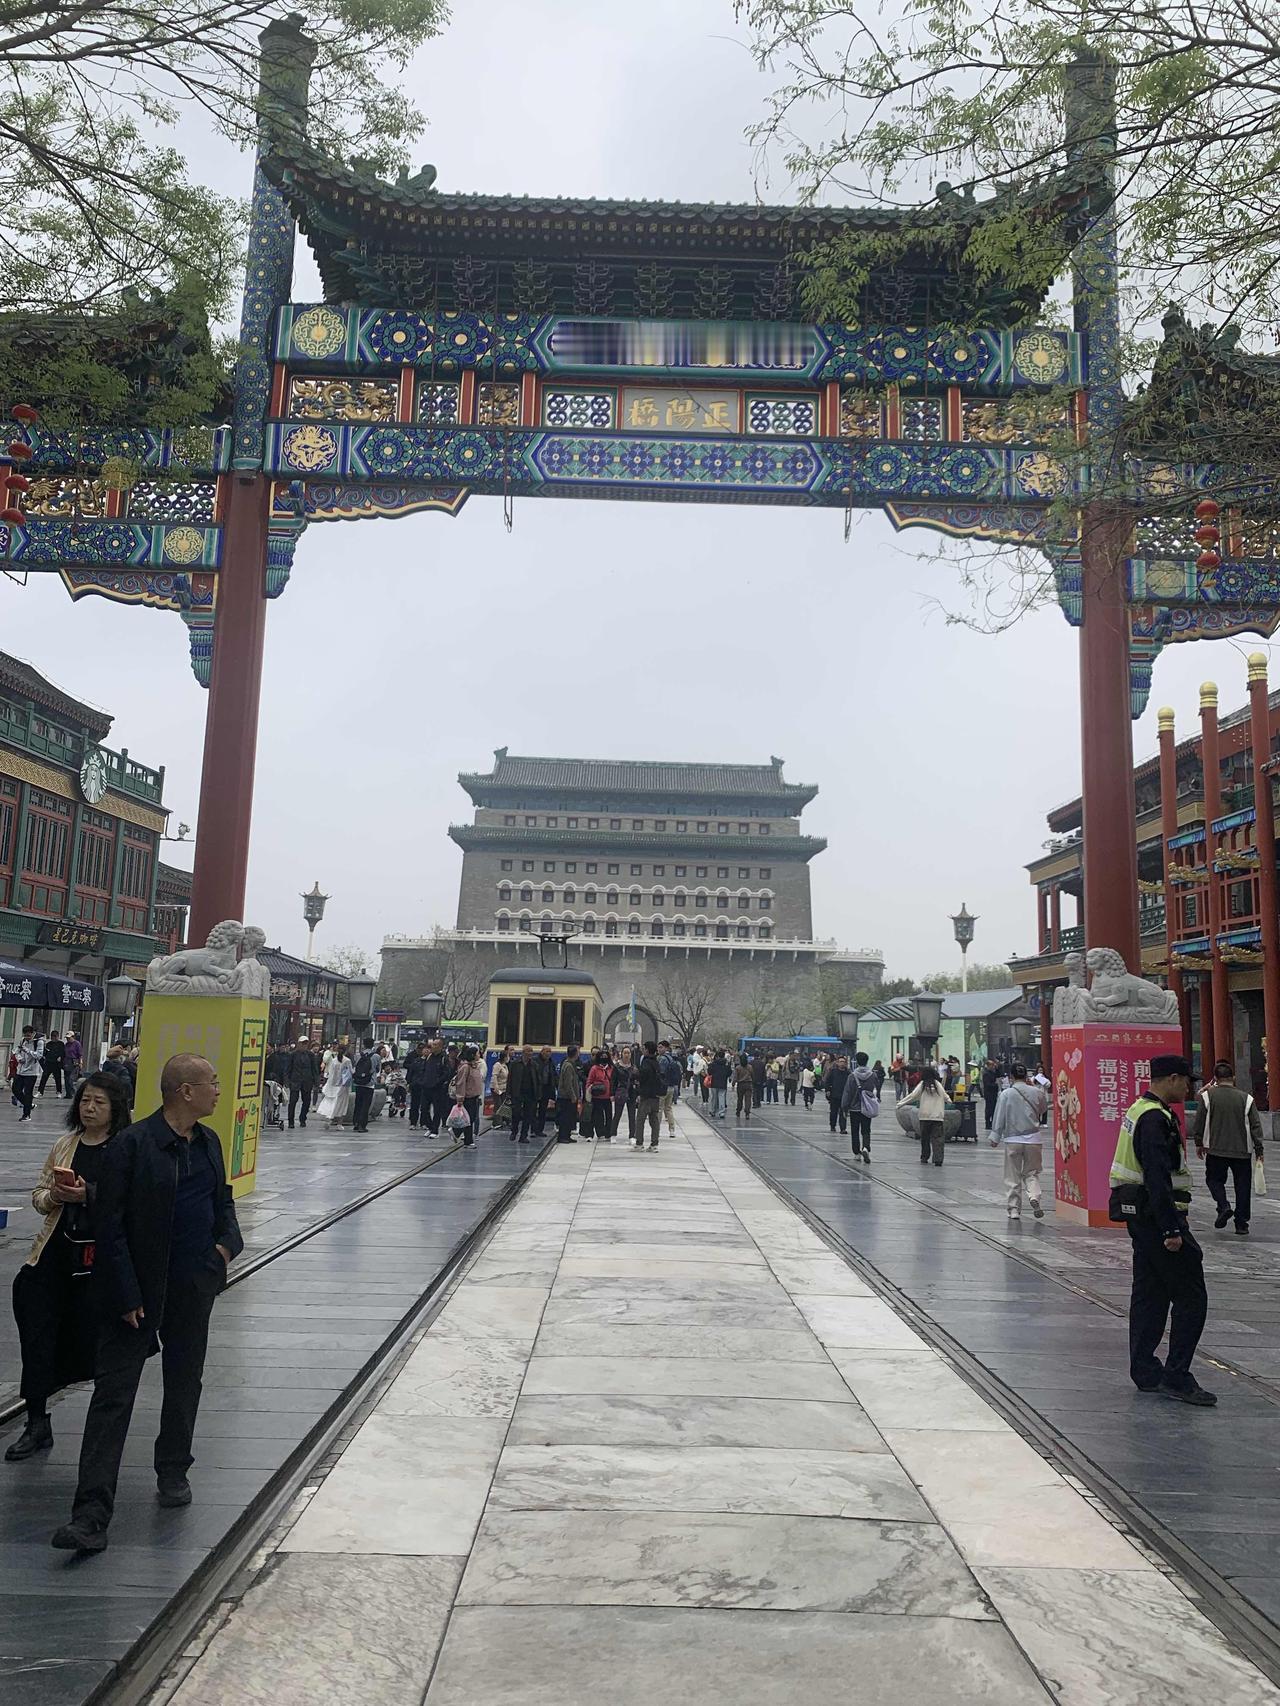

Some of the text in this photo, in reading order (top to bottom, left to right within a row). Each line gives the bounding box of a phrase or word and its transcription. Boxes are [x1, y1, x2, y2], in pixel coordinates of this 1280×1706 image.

[625, 396, 732, 430] 正陽橋
[52, 927, 98, 947] 星巴克咖啡
[6, 983, 21, 994] POLICE
[20, 979, 32, 1000] 察
[1119, 1059, 1128, 1084] 2026
[1097, 1058, 1120, 1121] 福马迎春
[1120, 1086, 1129, 1105] The
